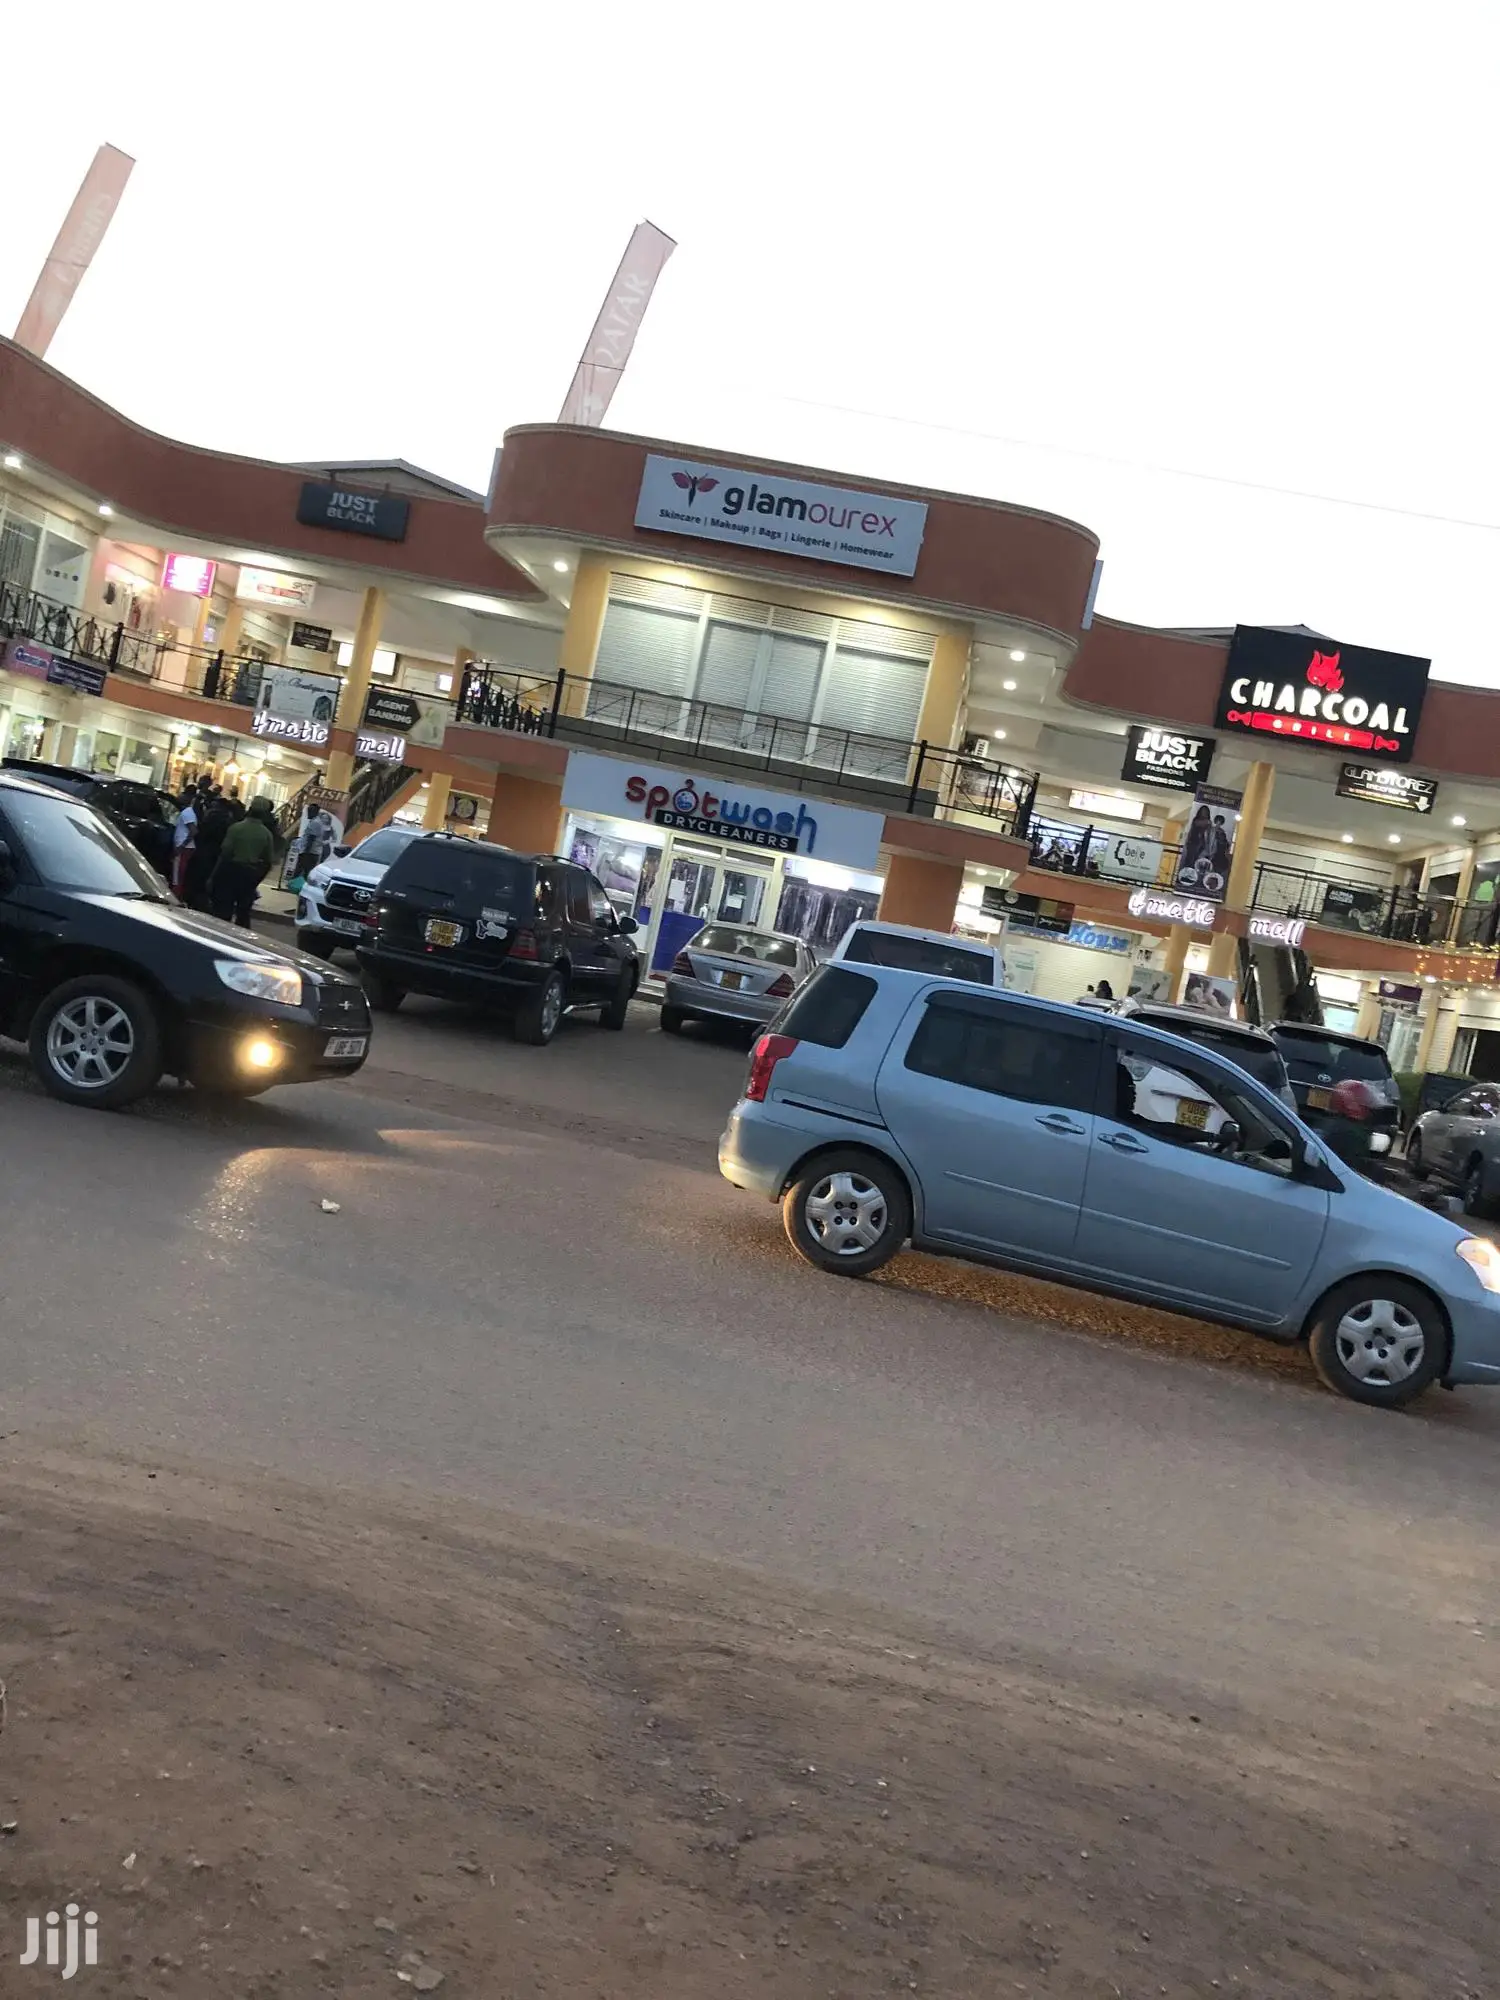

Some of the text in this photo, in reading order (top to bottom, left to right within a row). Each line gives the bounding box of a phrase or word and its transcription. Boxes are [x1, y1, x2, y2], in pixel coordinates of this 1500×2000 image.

[329, 492, 379, 512] JUST
[722, 484, 897, 537] glamourex
[327, 507, 376, 526] BLACK
[659, 509, 894, 559] Skincare Makeup Bags Lingerie Homewear
[368, 708, 412, 725] BANKING
[375, 698, 411, 713] AGENT
[1230, 678, 1409, 734] CHARCOAL
[252, 710, 328, 743] 4matic
[1273, 719, 1351, 742] GRILL
[356, 736, 406, 761] mall
[1138, 731, 1204, 757] JUST
[1135, 749, 1200, 772] BLACK
[625, 776, 817, 853] spotwash
[664, 813, 790, 848] DRYCLEANERS
[1128, 890, 1215, 925] 4matic
[1250, 917, 1304, 947] mall
